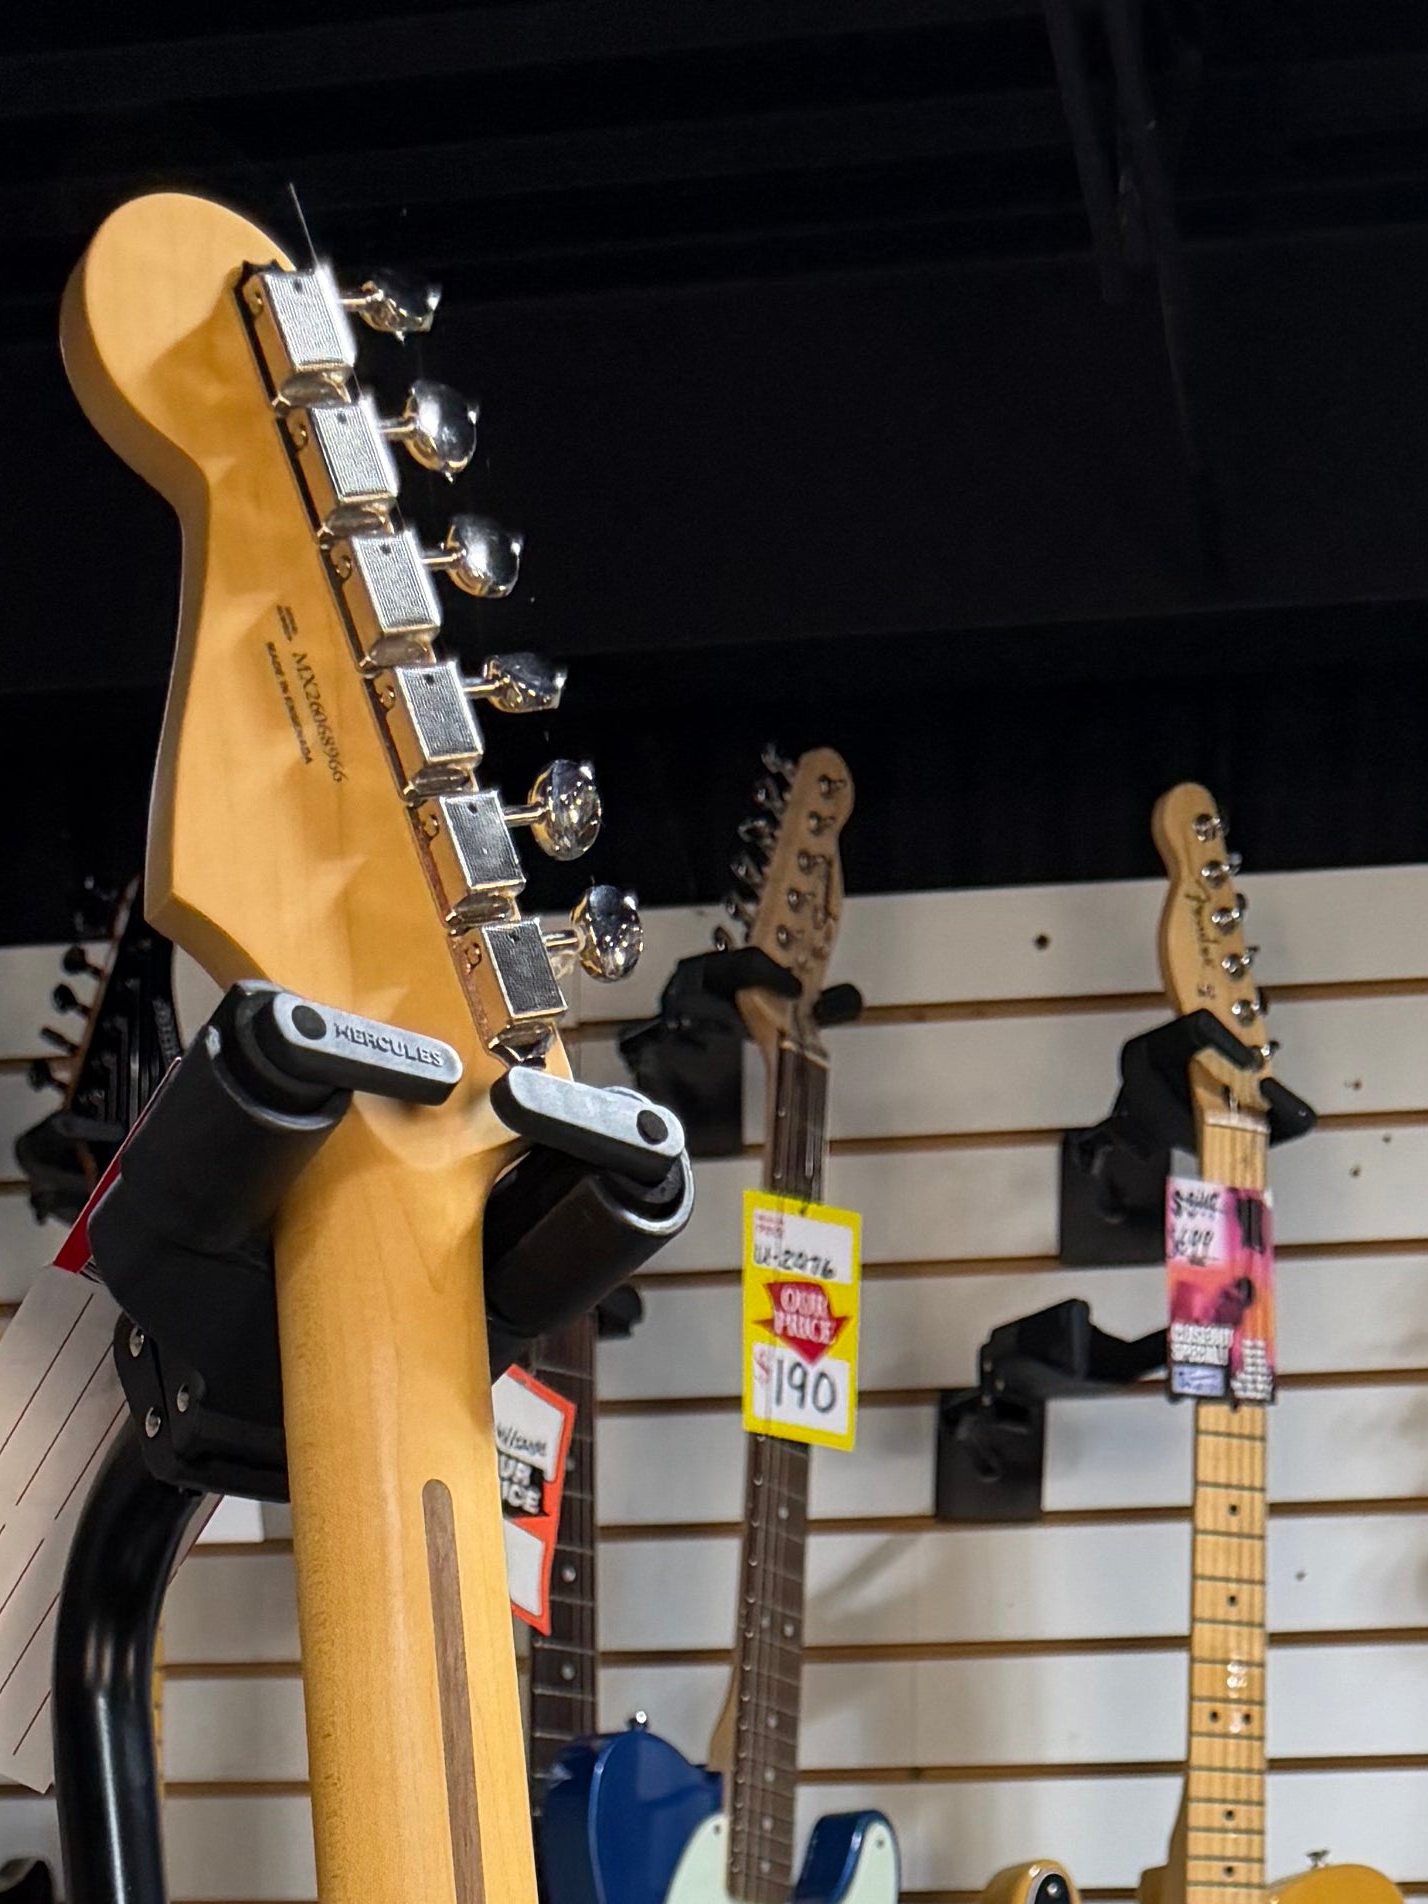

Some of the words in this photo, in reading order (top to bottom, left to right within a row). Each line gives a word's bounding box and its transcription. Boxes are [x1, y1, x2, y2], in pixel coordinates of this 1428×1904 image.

[334, 1022, 444, 1068] HERCULES
[780, 1285, 828, 1320] OUR
[774, 1311, 835, 1346] PRICE
[499, 1453, 531, 1487] UR
[501, 1481, 542, 1516] ICE
